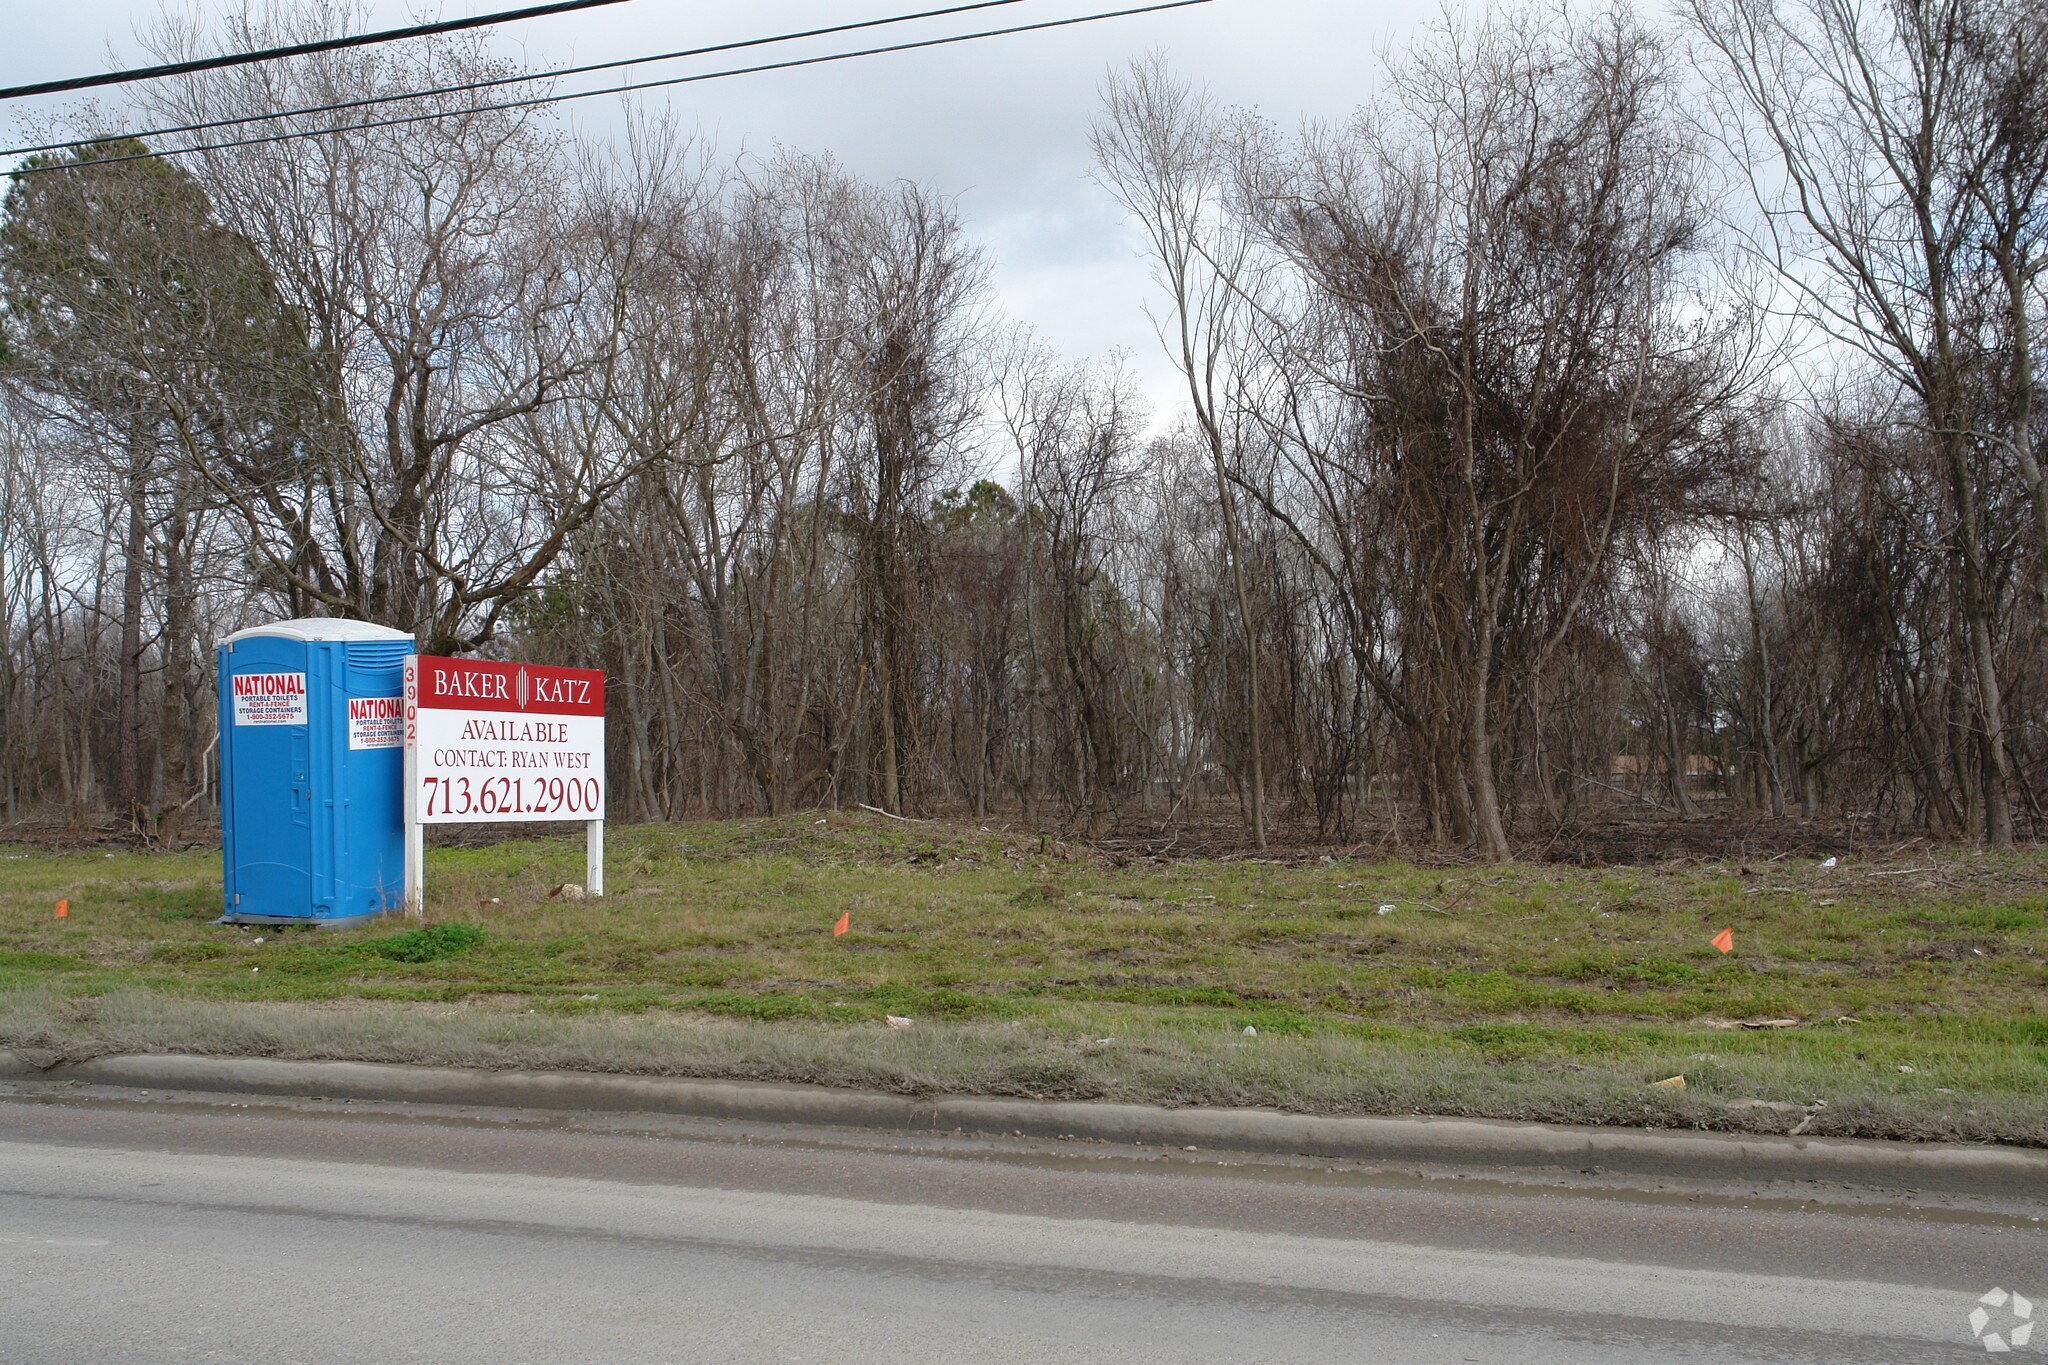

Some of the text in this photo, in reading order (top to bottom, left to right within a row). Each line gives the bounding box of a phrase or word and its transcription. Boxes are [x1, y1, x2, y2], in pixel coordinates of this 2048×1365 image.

[234, 675, 304, 695] NATIONAL
[434, 670, 591, 704] BAKER KATZ
[406, 666, 416, 740] 3902
[461, 720, 568, 743] AVAILABLE
[434, 749, 590, 769] CONTACT: RYAN WEST
[423, 776, 600, 816] 713.621.2900
